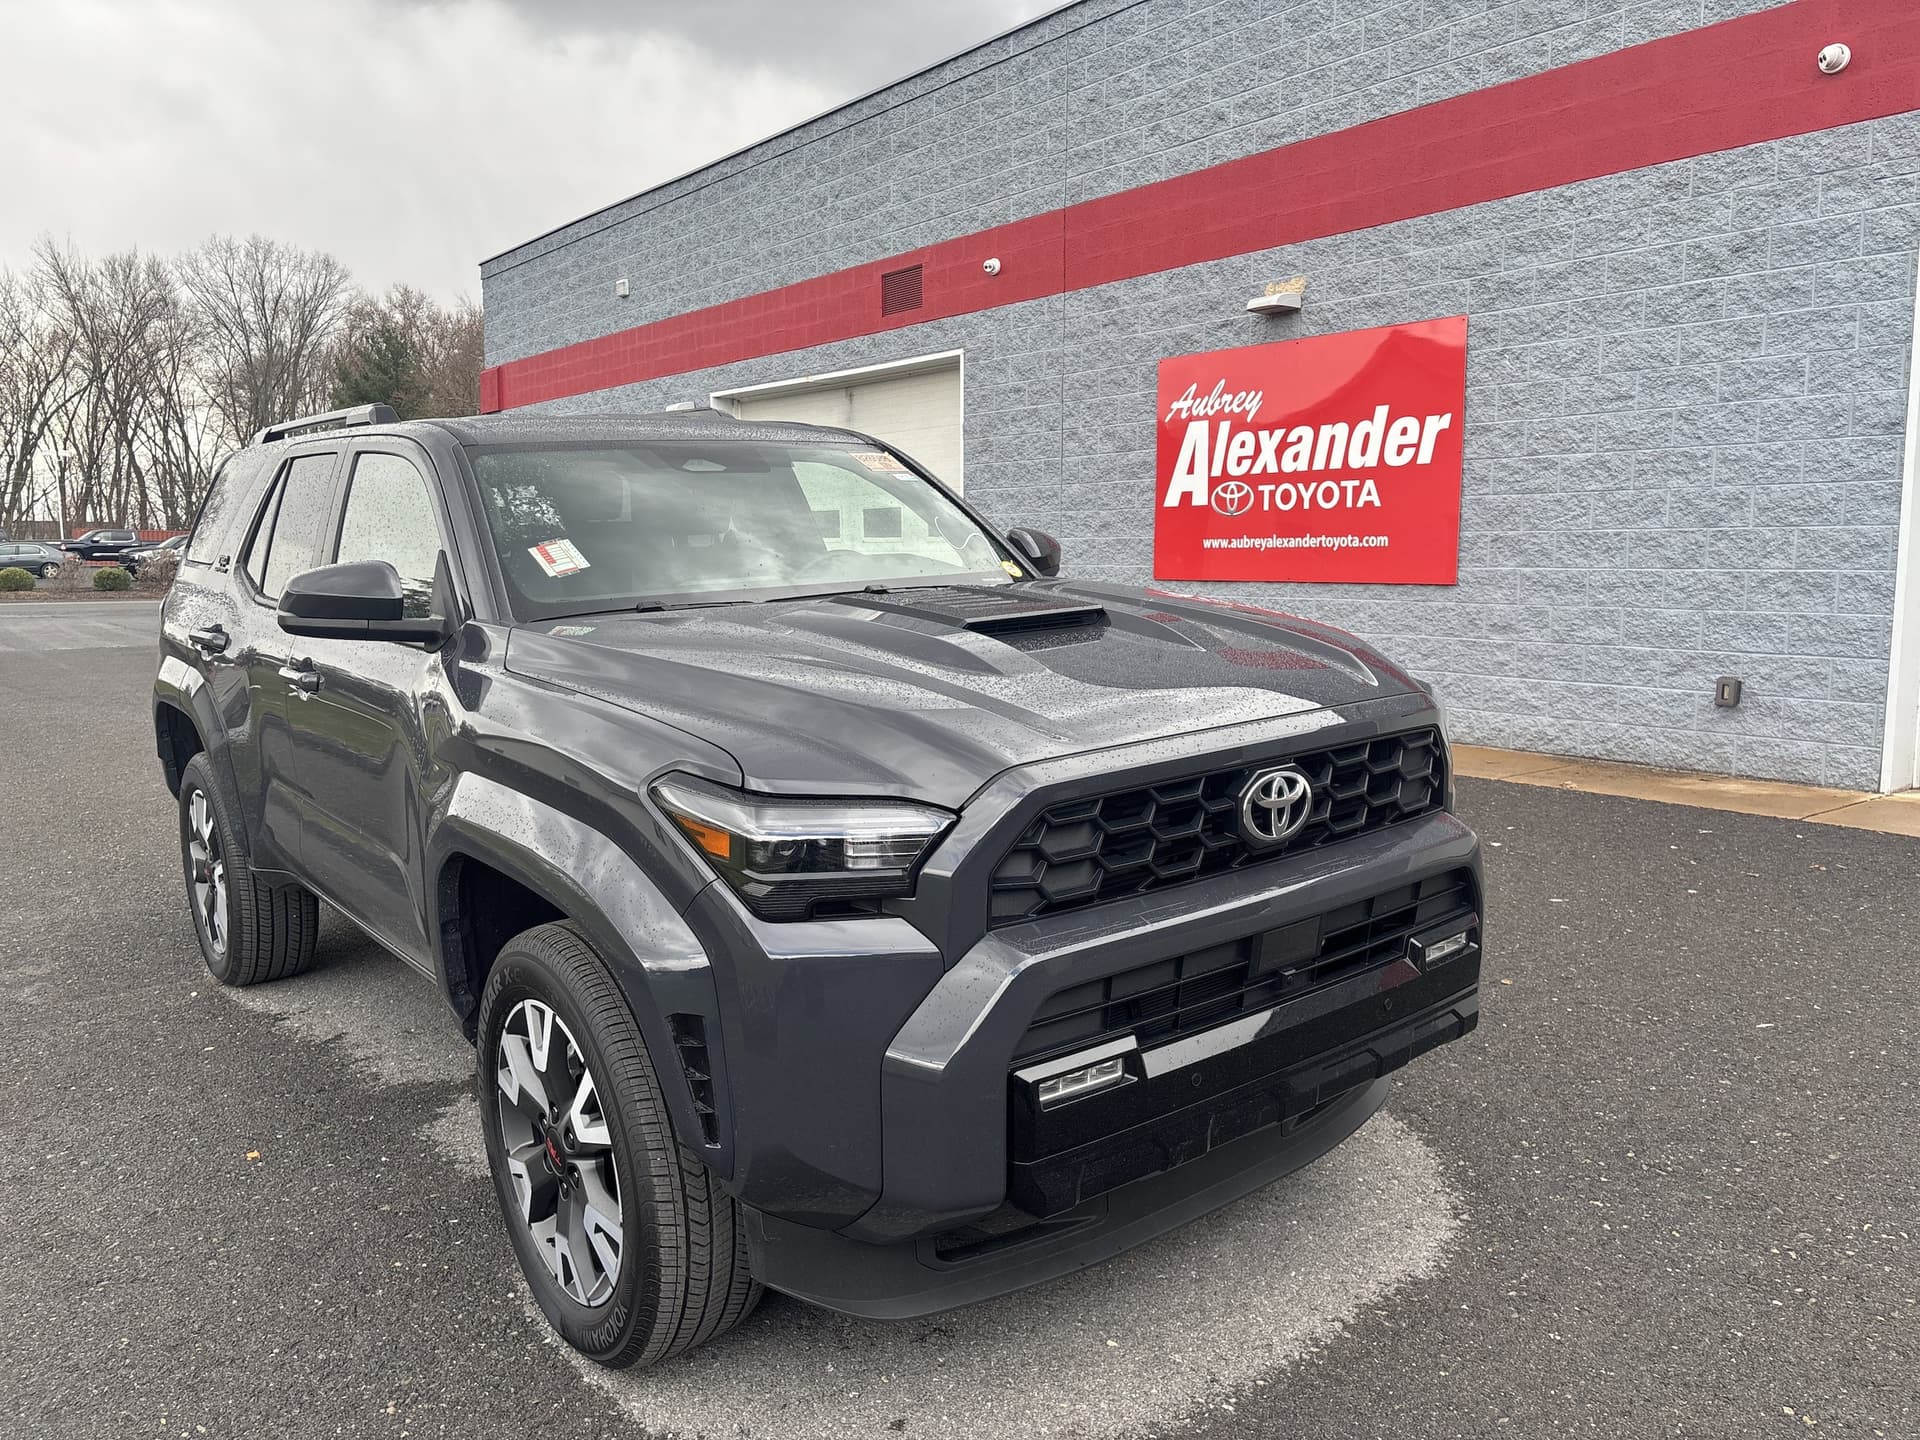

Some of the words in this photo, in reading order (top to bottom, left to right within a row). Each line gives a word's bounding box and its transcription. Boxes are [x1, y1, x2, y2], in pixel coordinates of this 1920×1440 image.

[1164, 378, 1264, 423] Aubrey
[1163, 404, 1452, 508] Alexander
[1258, 479, 1382, 511] TOYOTA
[1203, 533, 1389, 552] www.aubreyalexandertoyota.com
